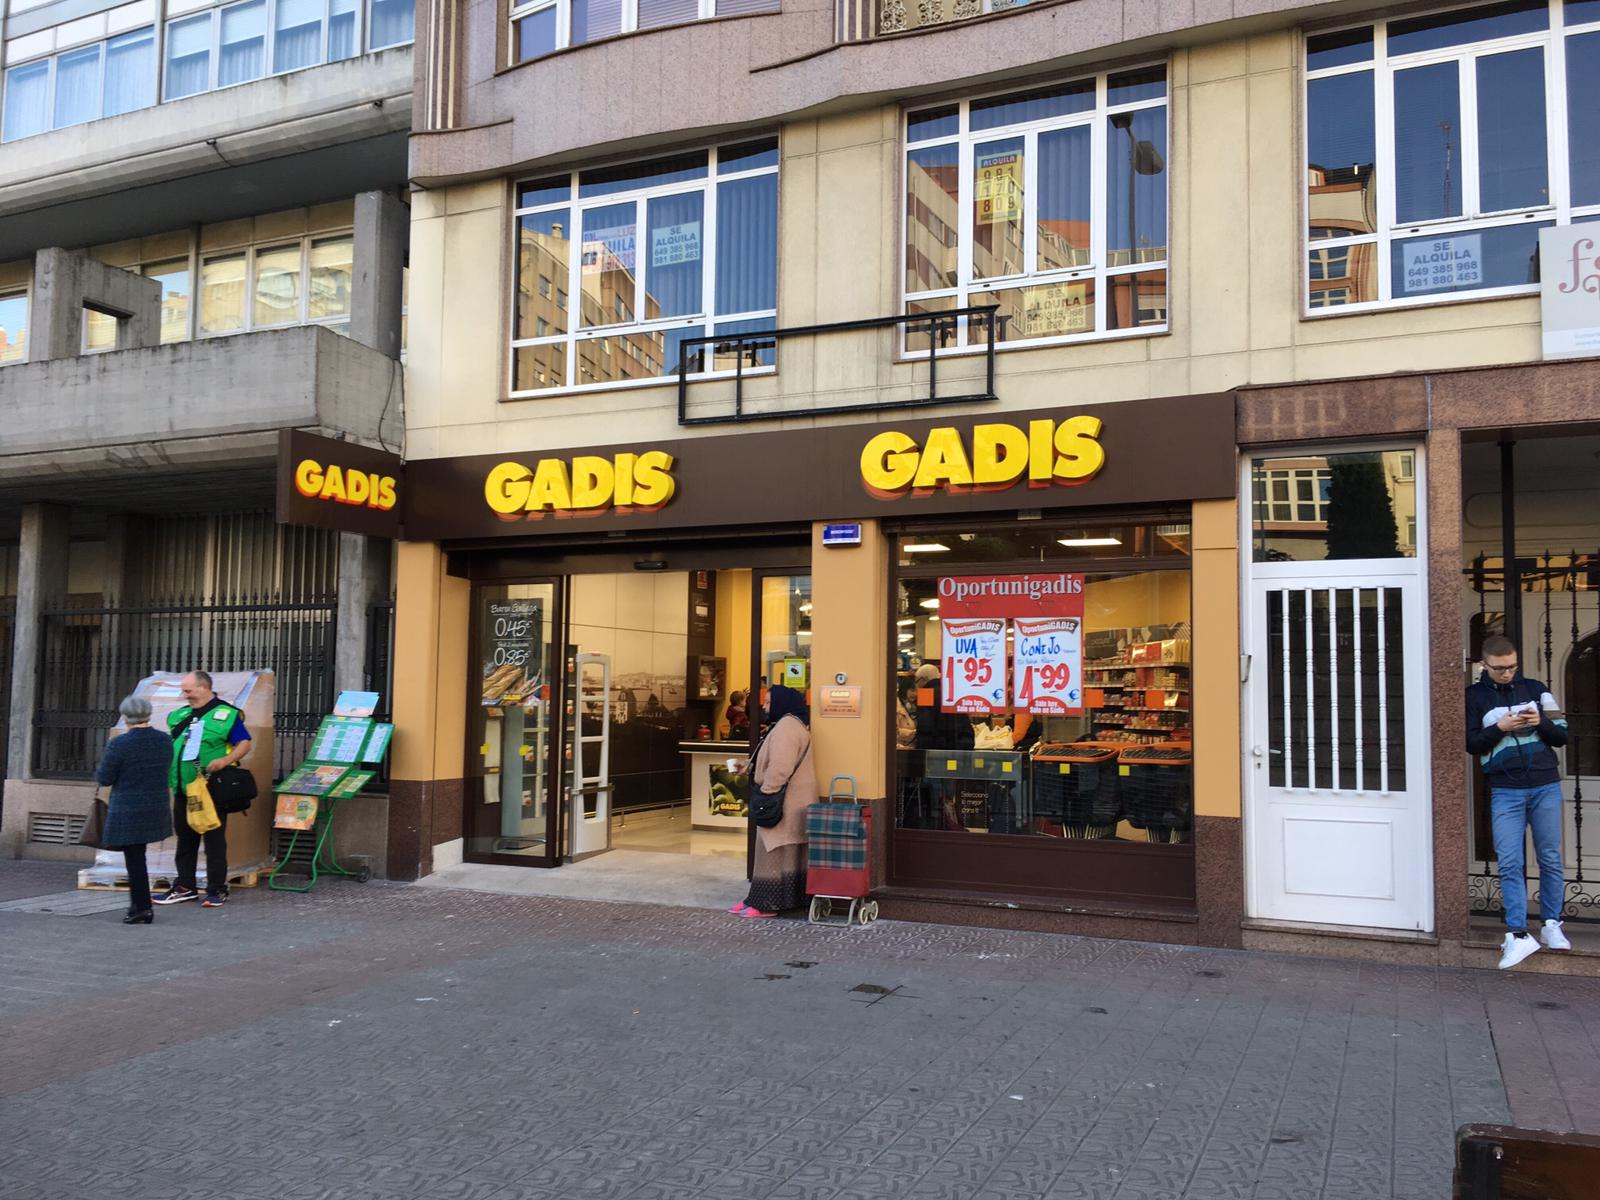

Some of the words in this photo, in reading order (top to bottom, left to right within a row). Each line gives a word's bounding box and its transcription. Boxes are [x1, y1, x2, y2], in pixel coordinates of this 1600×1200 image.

[670, 227, 682, 235] SE
[656, 233, 697, 247] ALQUILA
[1433, 241, 1450, 252] SE
[1413, 249, 1472, 265] ALQUILA
[1408, 267, 1429, 277] 649
[1432, 264, 1453, 274] 385
[1456, 261, 1478, 271] 968
[1408, 278, 1428, 288] 981
[1432, 275, 1453, 285] 880
[1457, 272, 1479, 281] 463
[860, 415, 1105, 493] GADIS
[295, 459, 397, 512] GADIS
[485, 450, 676, 517] GADIS
[939, 574, 1082, 601] Oportunigadis
[956, 638, 977, 658] UVA
